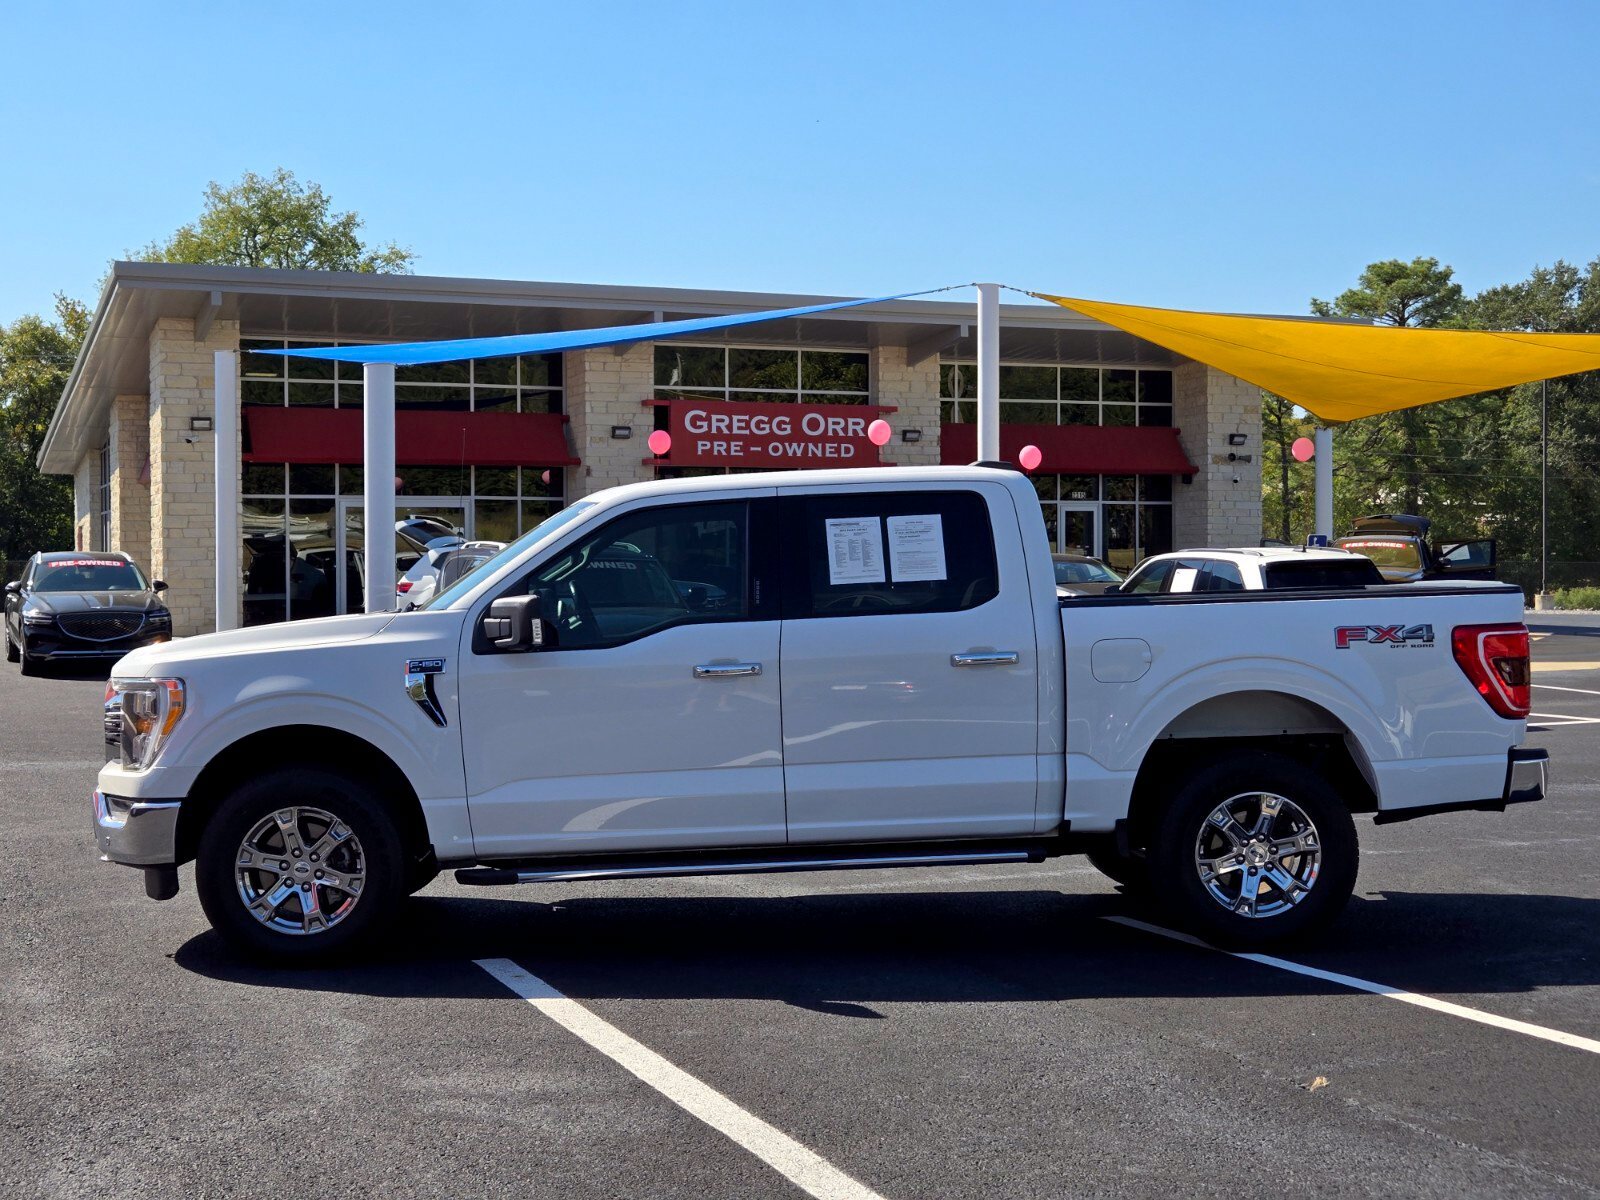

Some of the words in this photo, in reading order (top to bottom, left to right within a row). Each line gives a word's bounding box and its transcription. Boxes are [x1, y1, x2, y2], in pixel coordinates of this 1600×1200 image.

[684, 409, 792, 436] GREGG
[802, 412, 866, 437] ORR
[697, 440, 744, 457] PRE
[768, 441, 855, 458] OWNED
[1345, 541, 1403, 549] PRE-OWNED
[586, 561, 637, 570] WNED
[1334, 623, 1435, 649] FX4
